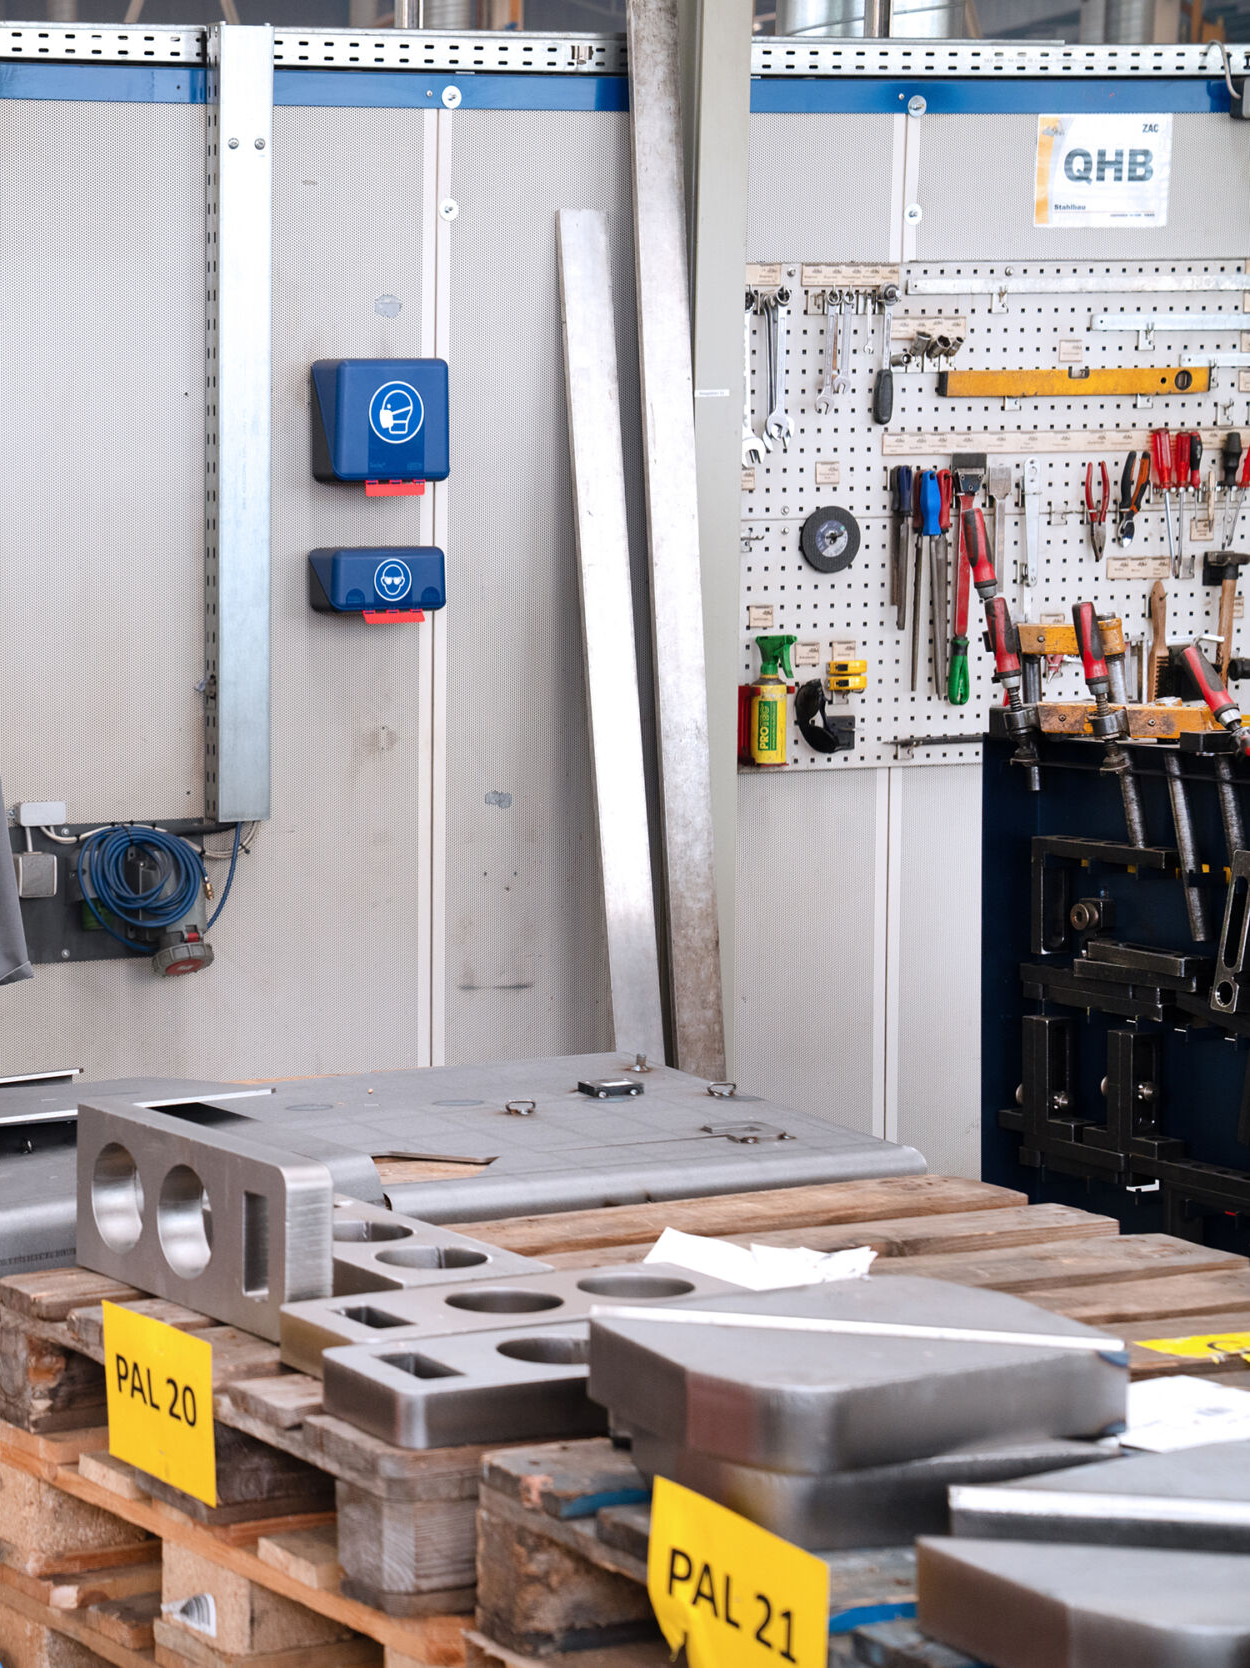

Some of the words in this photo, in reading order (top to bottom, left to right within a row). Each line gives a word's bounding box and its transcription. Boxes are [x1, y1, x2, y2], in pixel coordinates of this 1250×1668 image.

[1142, 124, 1159, 133] ZAC
[1064, 148, 1154, 185] QHB
[116, 1353, 160, 1411] PAL
[166, 1379, 197, 1427] 20
[667, 1547, 740, 1630] PAL
[754, 1592, 797, 1664] 21
